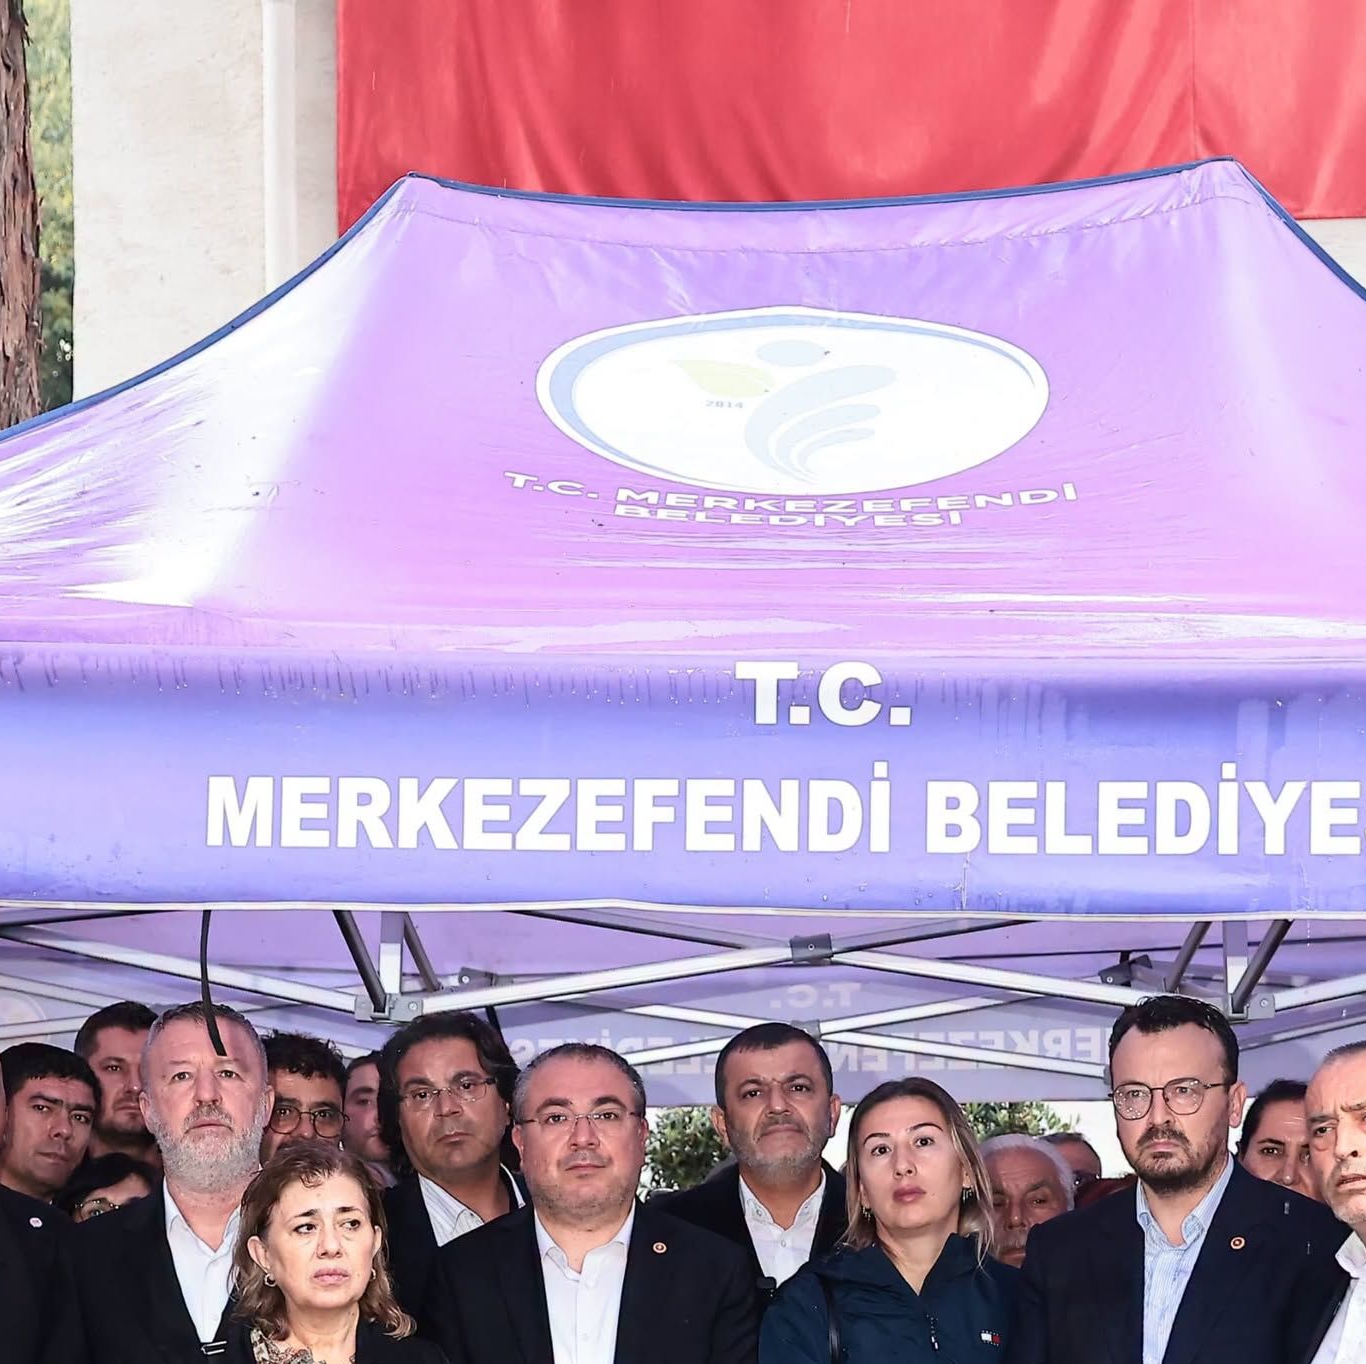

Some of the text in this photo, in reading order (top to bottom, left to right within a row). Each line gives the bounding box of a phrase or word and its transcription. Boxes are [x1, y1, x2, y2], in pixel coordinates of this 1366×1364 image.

[503, 471, 1078, 512] T.C. MERKEZEFENDİ
[736, 660, 912, 726] T.C.
[205, 760, 891, 853] MERKEZEFENDİ
